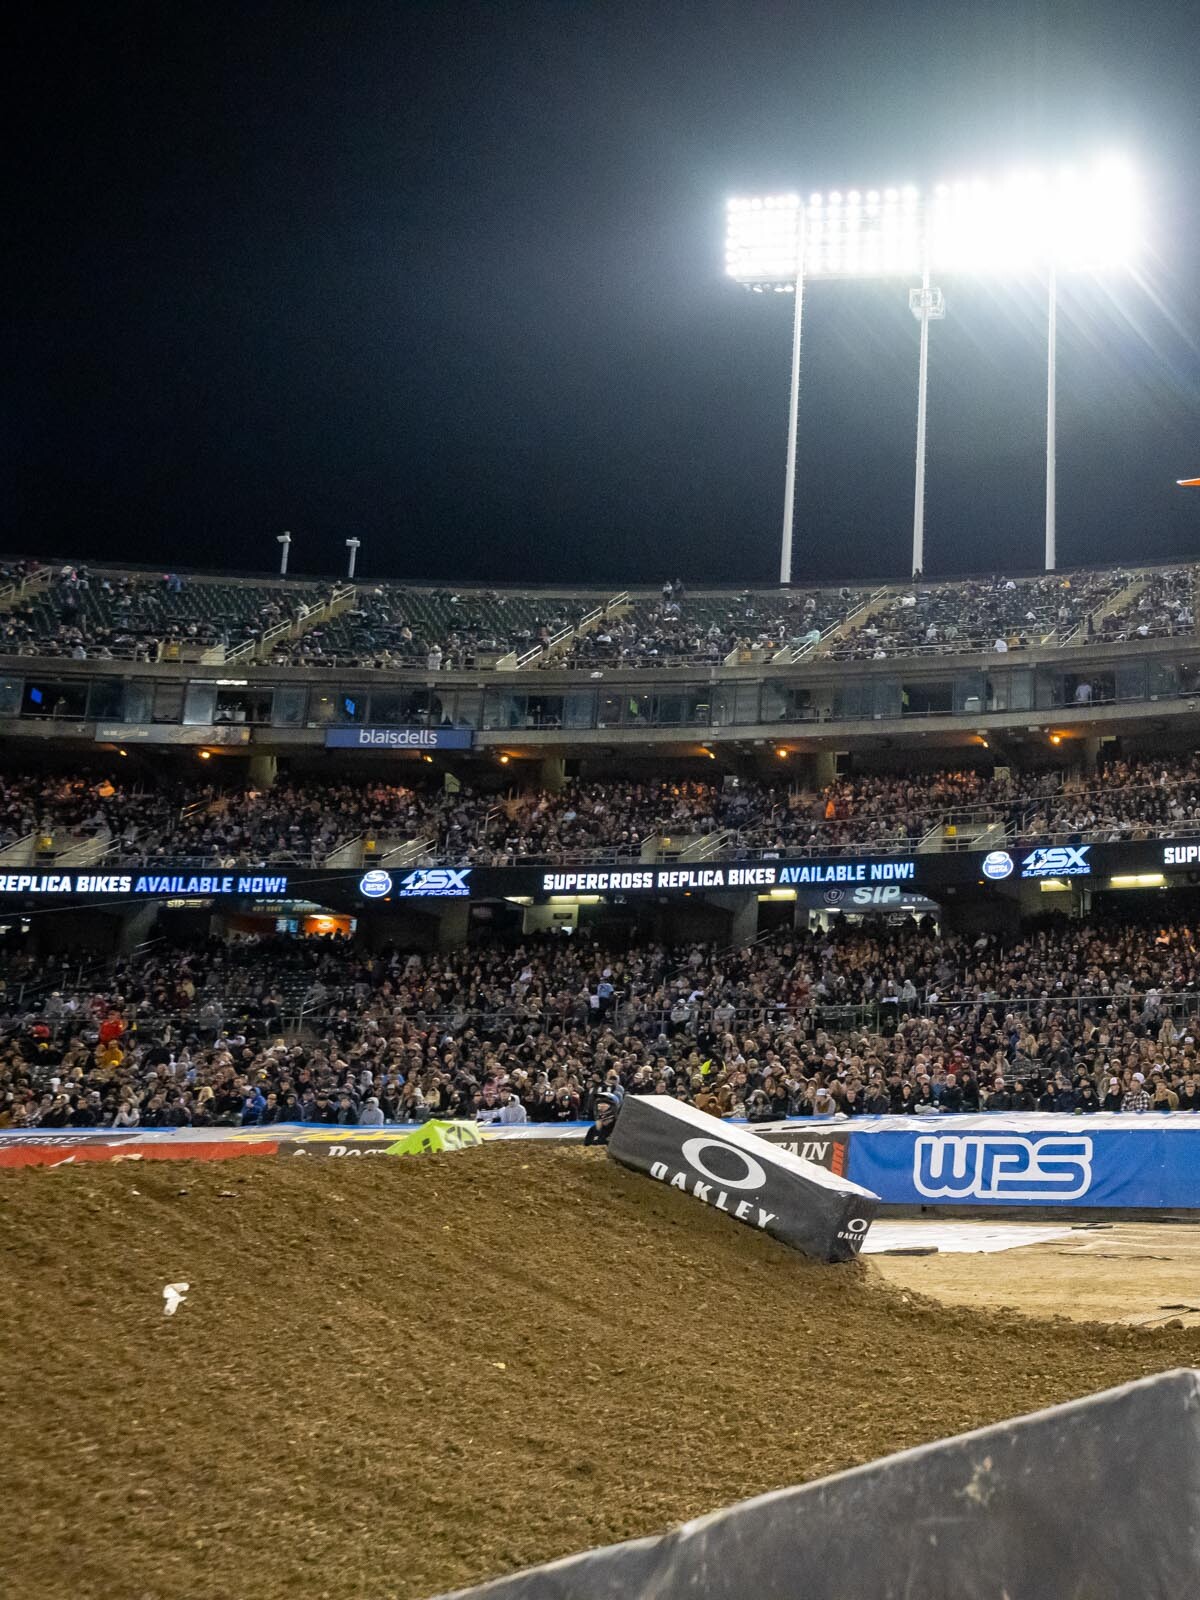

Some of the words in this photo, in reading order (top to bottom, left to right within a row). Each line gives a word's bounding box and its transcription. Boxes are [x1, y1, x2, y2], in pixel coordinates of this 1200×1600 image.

[359, 729, 438, 744] blaisdells
[76, 876, 132, 892] BIKES
[135, 876, 234, 893] AVAILABLE
[237, 877, 287, 893] NOW!
[543, 872, 653, 891] SUPERCROSS
[657, 870, 724, 888] REPLICA
[728, 868, 776, 885] BIKES
[779, 864, 866, 883] AVAILABLE
[870, 862, 915, 880] NOW!
[853, 886, 901, 905] SIP
[913, 1135, 1093, 1200] WPS
[650, 1161, 779, 1229] OAKLEY
